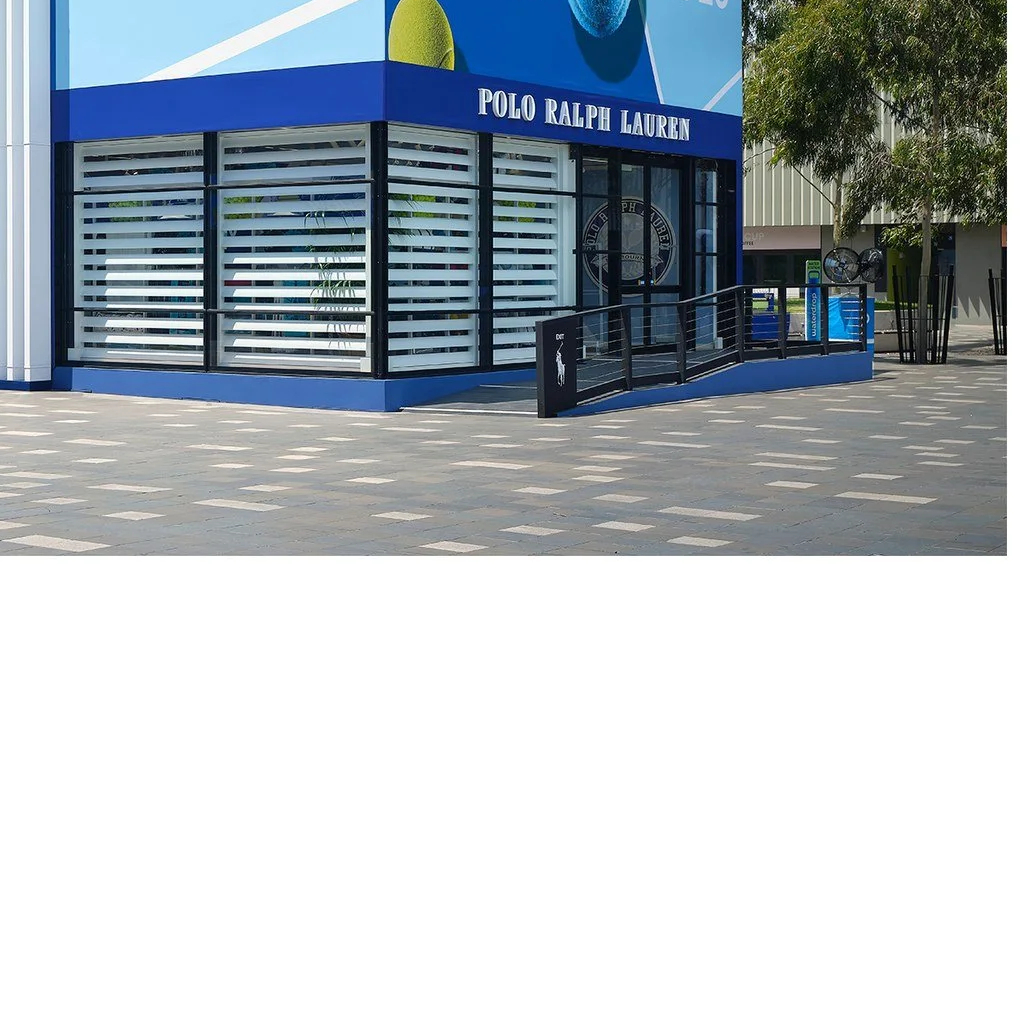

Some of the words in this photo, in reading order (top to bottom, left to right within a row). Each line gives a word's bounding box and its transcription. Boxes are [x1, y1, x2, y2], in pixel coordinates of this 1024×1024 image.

[478, 87, 536, 122] POLO
[544, 98, 611, 132] RALPH
[620, 109, 690, 142] LAUREN
[599, 202, 636, 222] RPH
